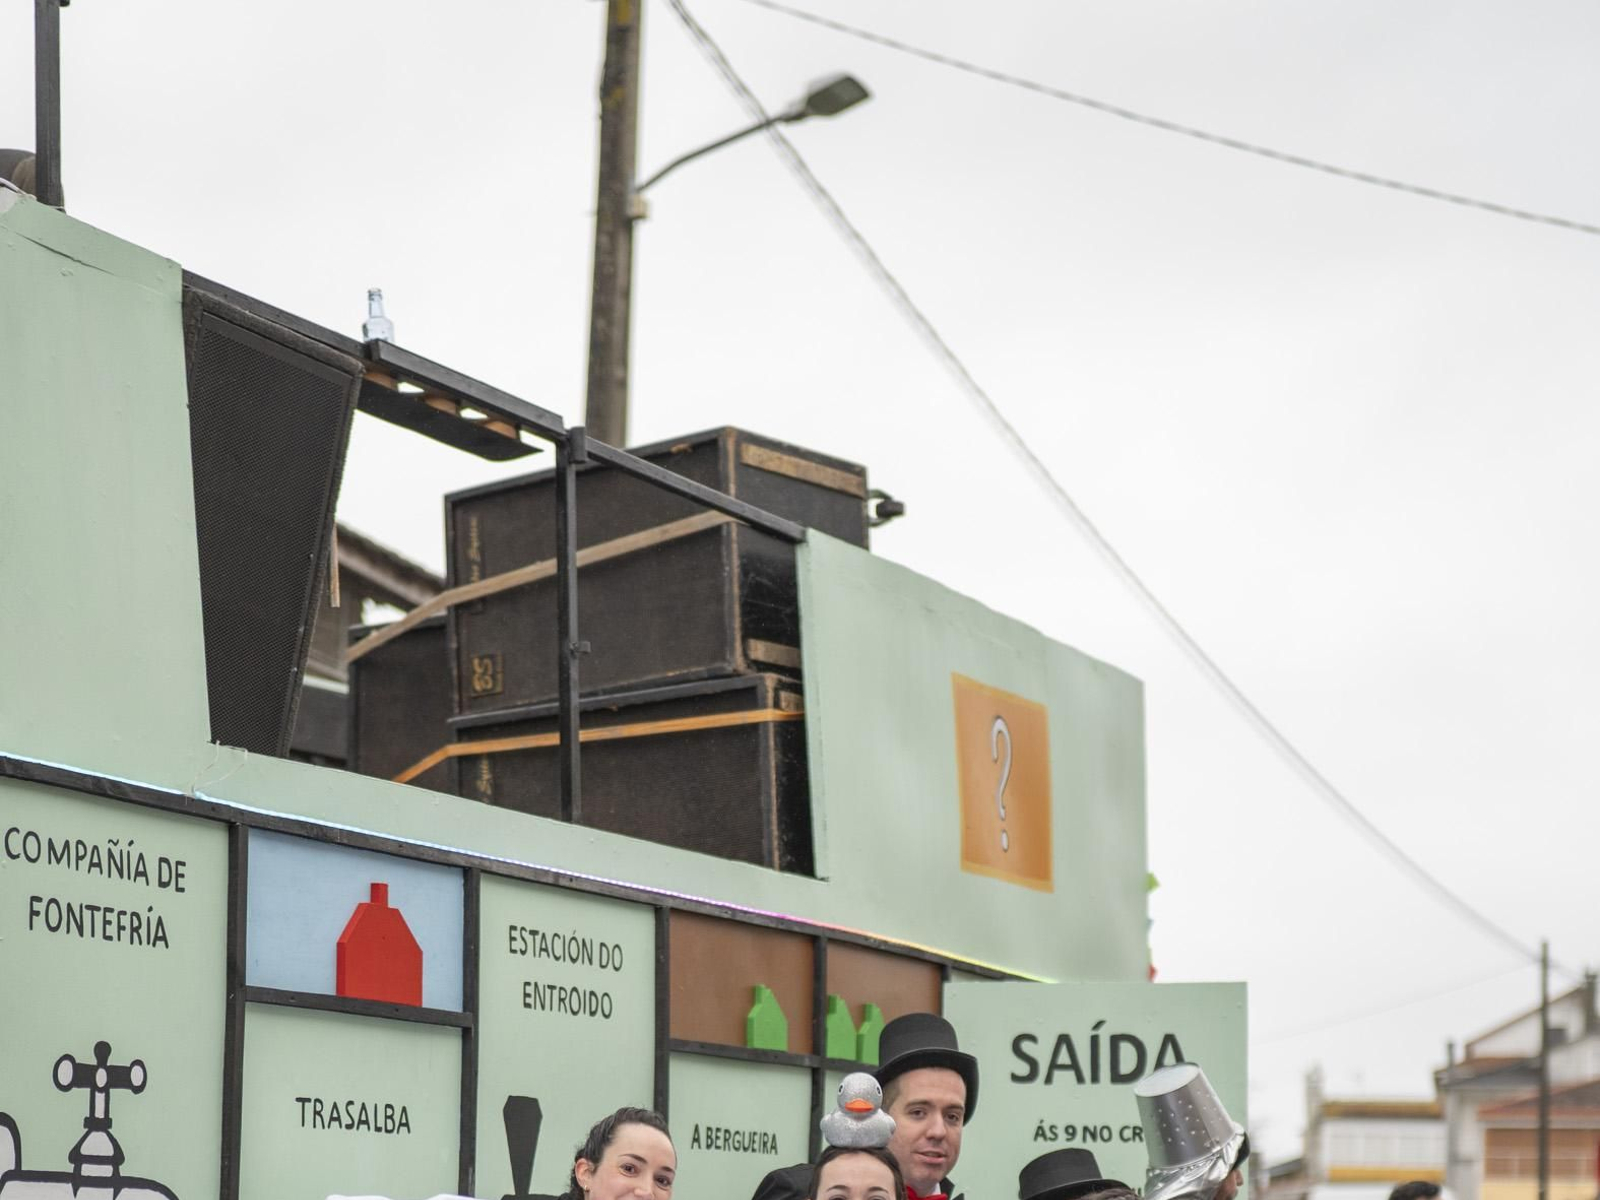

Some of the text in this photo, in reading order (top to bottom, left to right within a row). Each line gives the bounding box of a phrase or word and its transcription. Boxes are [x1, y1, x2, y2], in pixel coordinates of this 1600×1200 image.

[991, 714, 1013, 853] ?
[4, 826, 186, 893] COMPAÑÍA DE
[28, 895, 169, 949] FONTEFRÍA
[508, 924, 623, 972] ESTACIÓN DO
[522, 981, 613, 1020] ENTROIDO
[1010, 1019, 1188, 1086] SAÍDA
[295, 1096, 411, 1135] TRASALBA
[1033, 1118, 1059, 1143] ÁS
[1064, 1123, 1078, 1143] 9
[1082, 1124, 1113, 1144] NO
[705, 1126, 778, 1155] BERGUEIRA
